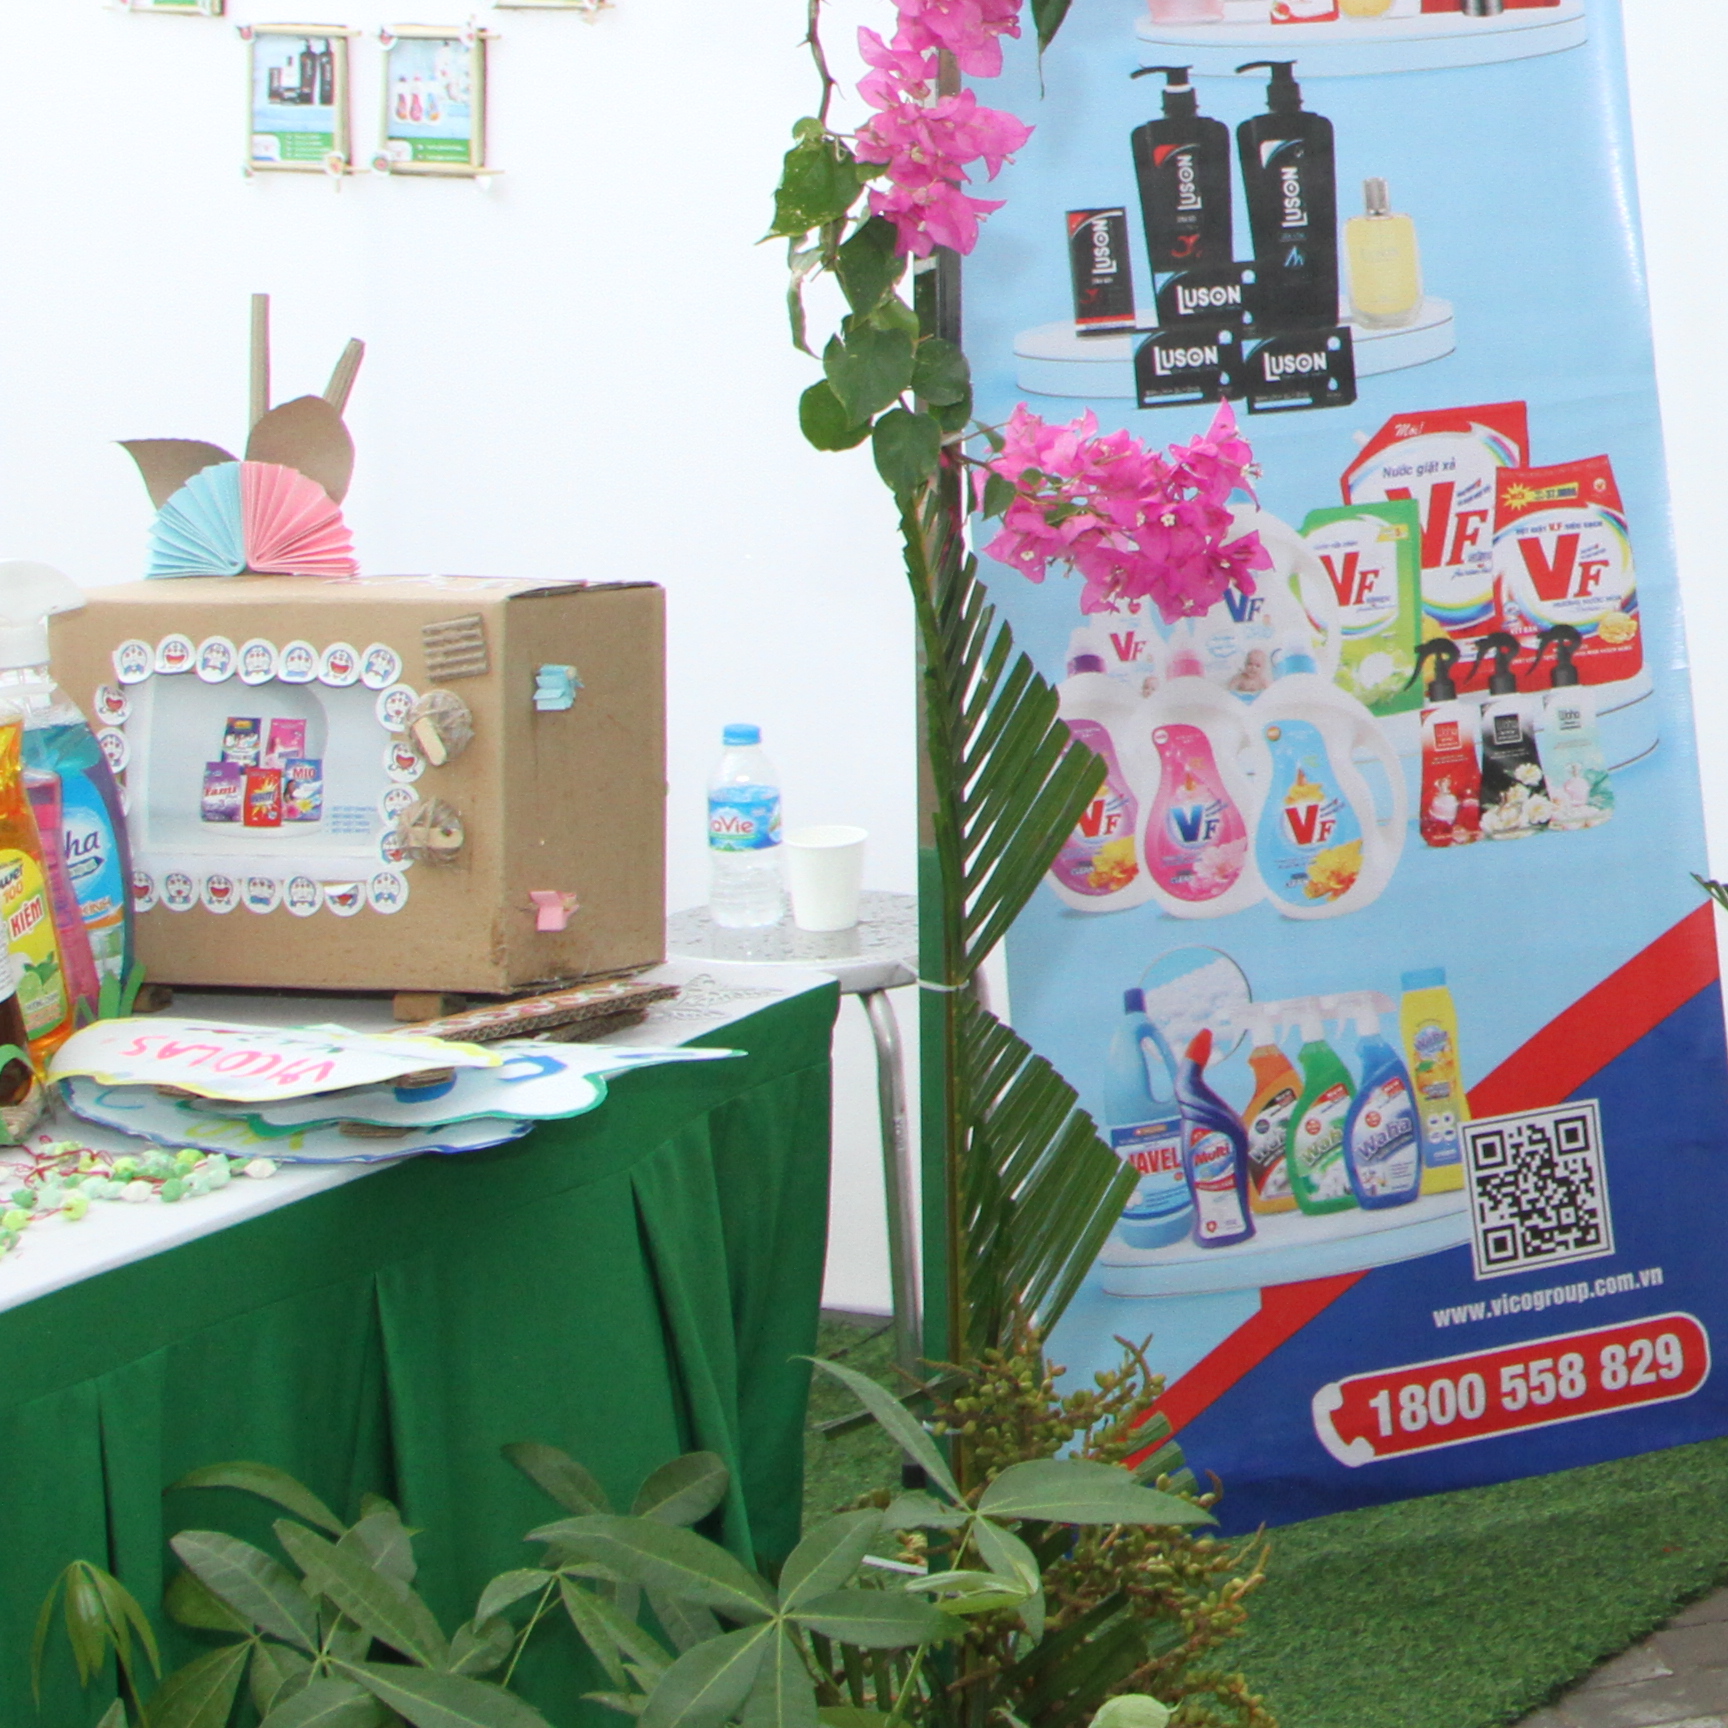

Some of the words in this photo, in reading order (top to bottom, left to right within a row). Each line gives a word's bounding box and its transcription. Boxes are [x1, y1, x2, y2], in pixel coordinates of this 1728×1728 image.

[1177, 154, 1202, 211] LUSON
[1281, 166, 1308, 228] LUSON
[1091, 219, 1118, 274] LUSON
[1176, 284, 1241, 315] LUSON
[1153, 344, 1219, 376] LUSON
[1263, 351, 1328, 382] LUSON
[1319, 551, 1380, 608] VF
[1517, 533, 1609, 602] VF
[1223, 587, 1265, 623] VF
[1110, 631, 1147, 662] VF
[1076, 799, 1122, 838] VF
[1168, 804, 1220, 843] VF
[1285, 803, 1336, 845] VF
[1433, 1266, 1664, 1328] www.vicogroup.com.vn
[1369, 1373, 1487, 1437] 1800
[1500, 1352, 1587, 1411] 558
[1600, 1333, 1685, 1391] 829
